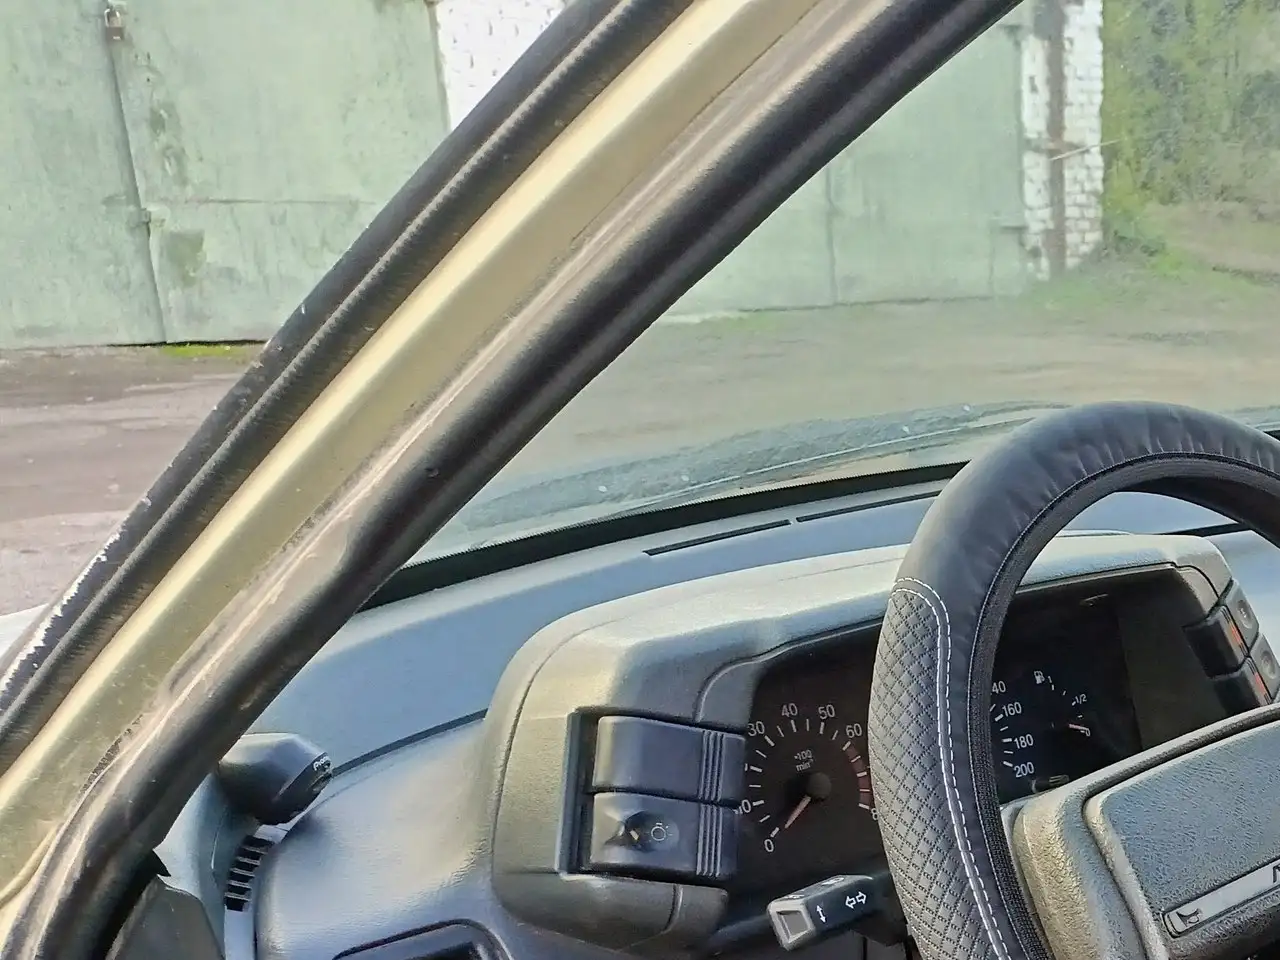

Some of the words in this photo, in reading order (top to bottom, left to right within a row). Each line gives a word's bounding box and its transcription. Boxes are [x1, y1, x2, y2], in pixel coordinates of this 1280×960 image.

[990, 680, 1007, 694] 40
[781, 702, 798, 718] 40
[818, 704, 835, 720] 50
[1001, 701, 1022, 718] 160
[748, 721, 765, 737] 30
[845, 723, 862, 738] 60
[1014, 733, 1034, 749] 180
[1013, 761, 1035, 778] 200
[871, 807, 879, 821] 8
[764, 839, 774, 852] 0
